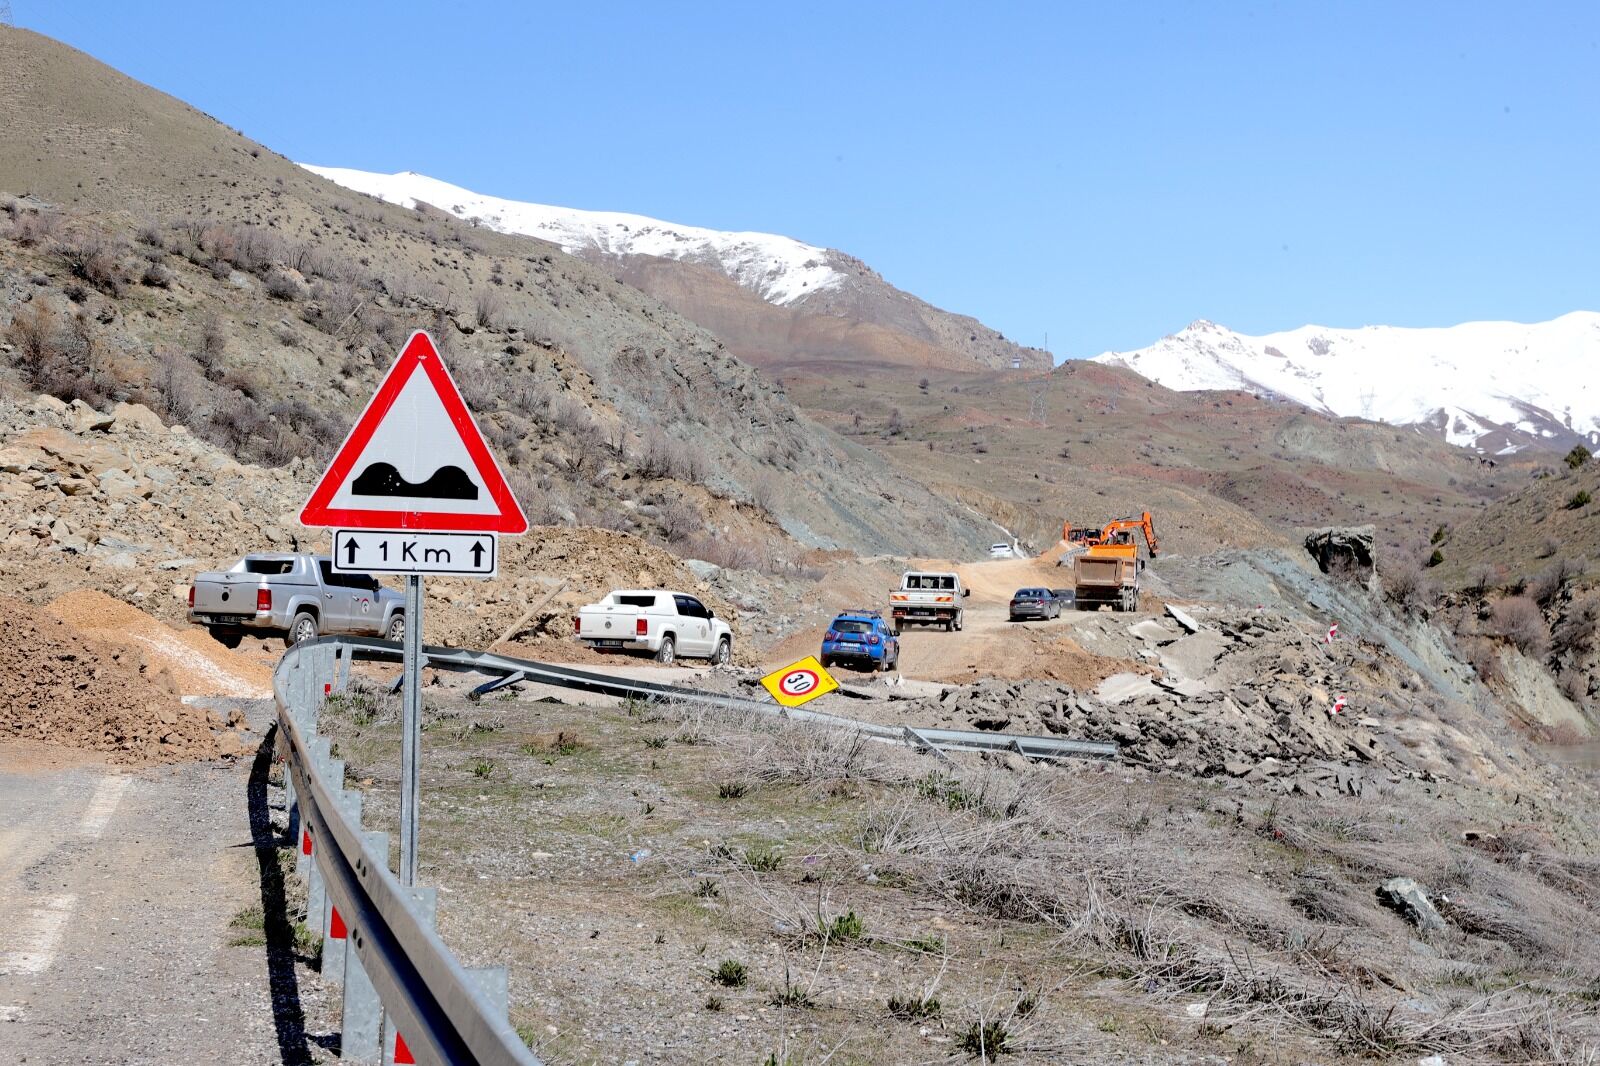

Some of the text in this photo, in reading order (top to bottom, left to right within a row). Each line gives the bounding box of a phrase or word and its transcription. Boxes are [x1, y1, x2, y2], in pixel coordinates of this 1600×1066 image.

[379, 541, 451, 563] 1 Km
[787, 673, 811, 692] 30
